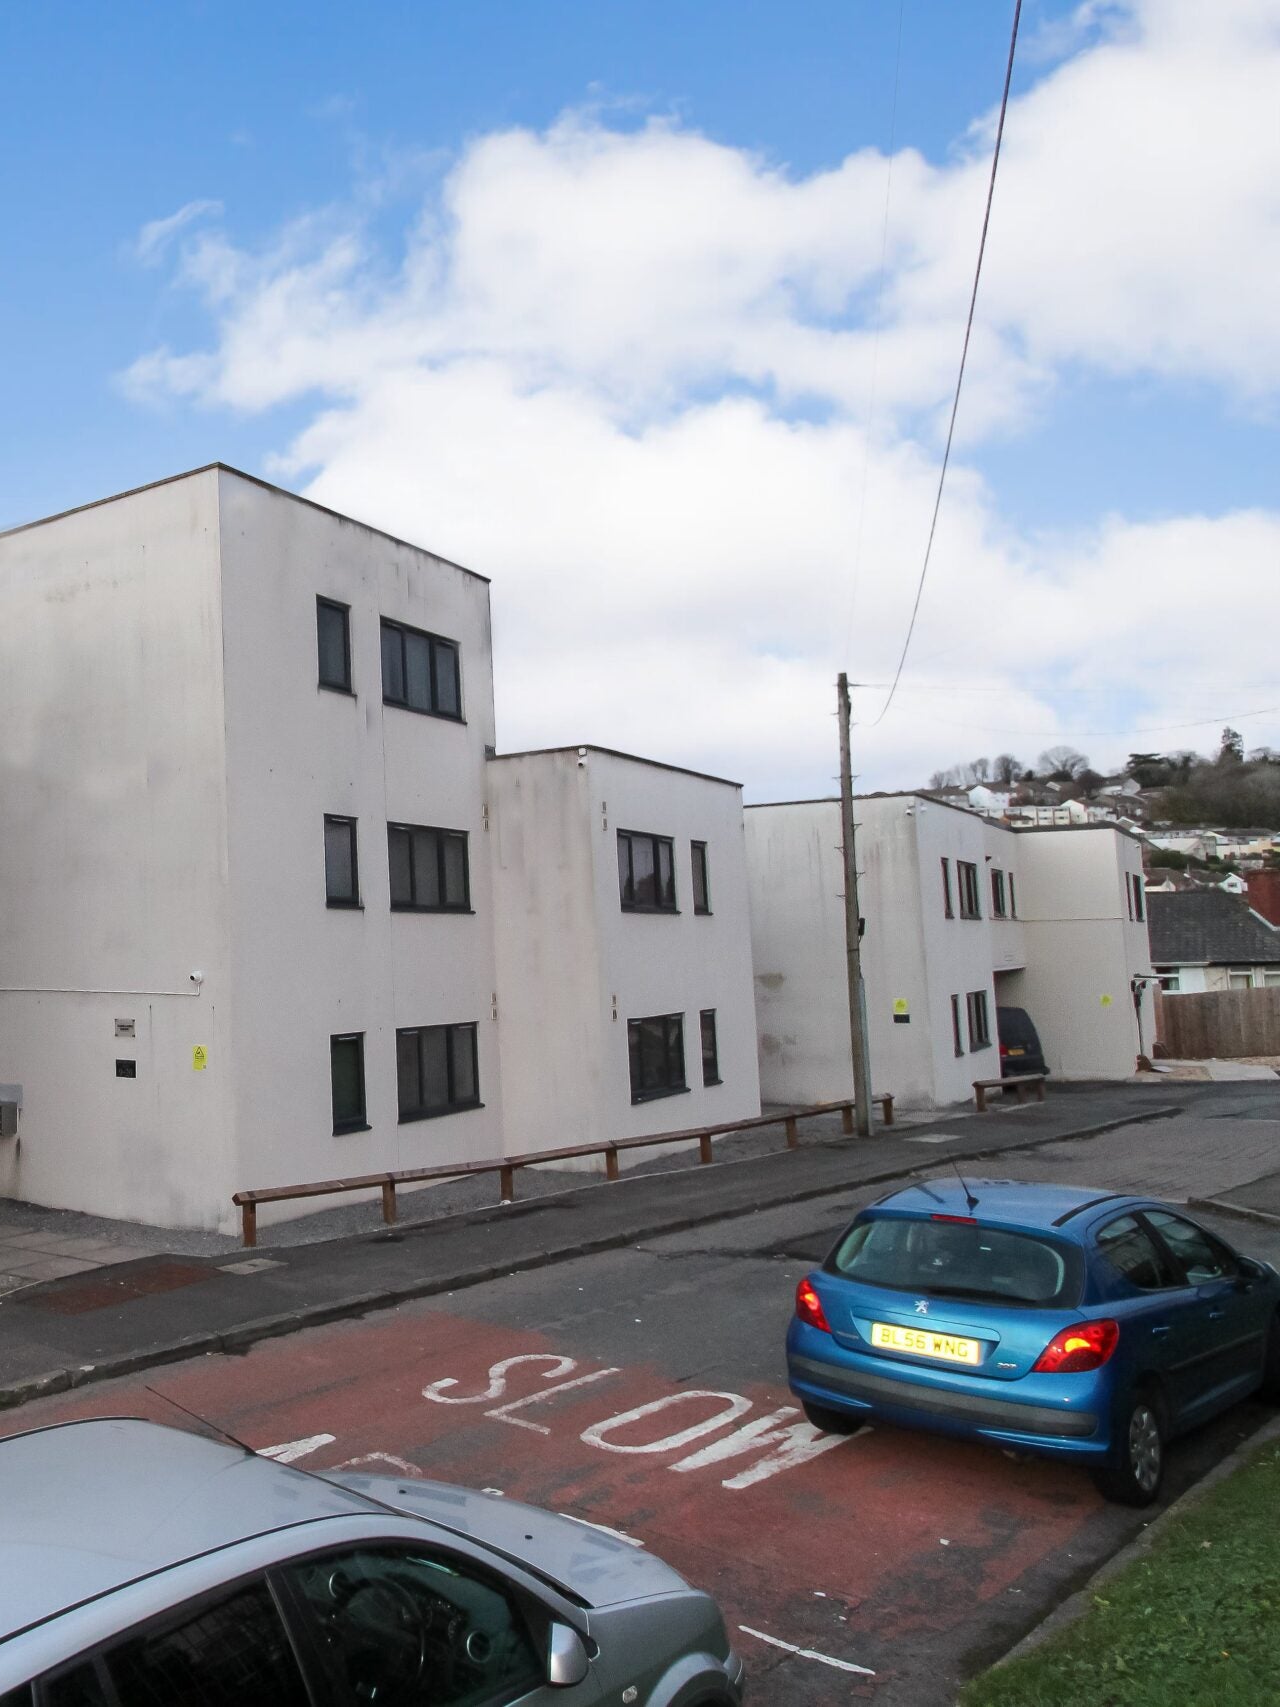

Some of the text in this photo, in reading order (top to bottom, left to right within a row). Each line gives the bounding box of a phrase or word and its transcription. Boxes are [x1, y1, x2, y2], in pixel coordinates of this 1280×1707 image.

[880, 1327, 926, 1349] BL56
[933, 1337, 968, 1357] WNG
[422, 1354, 873, 1489] SLOW
